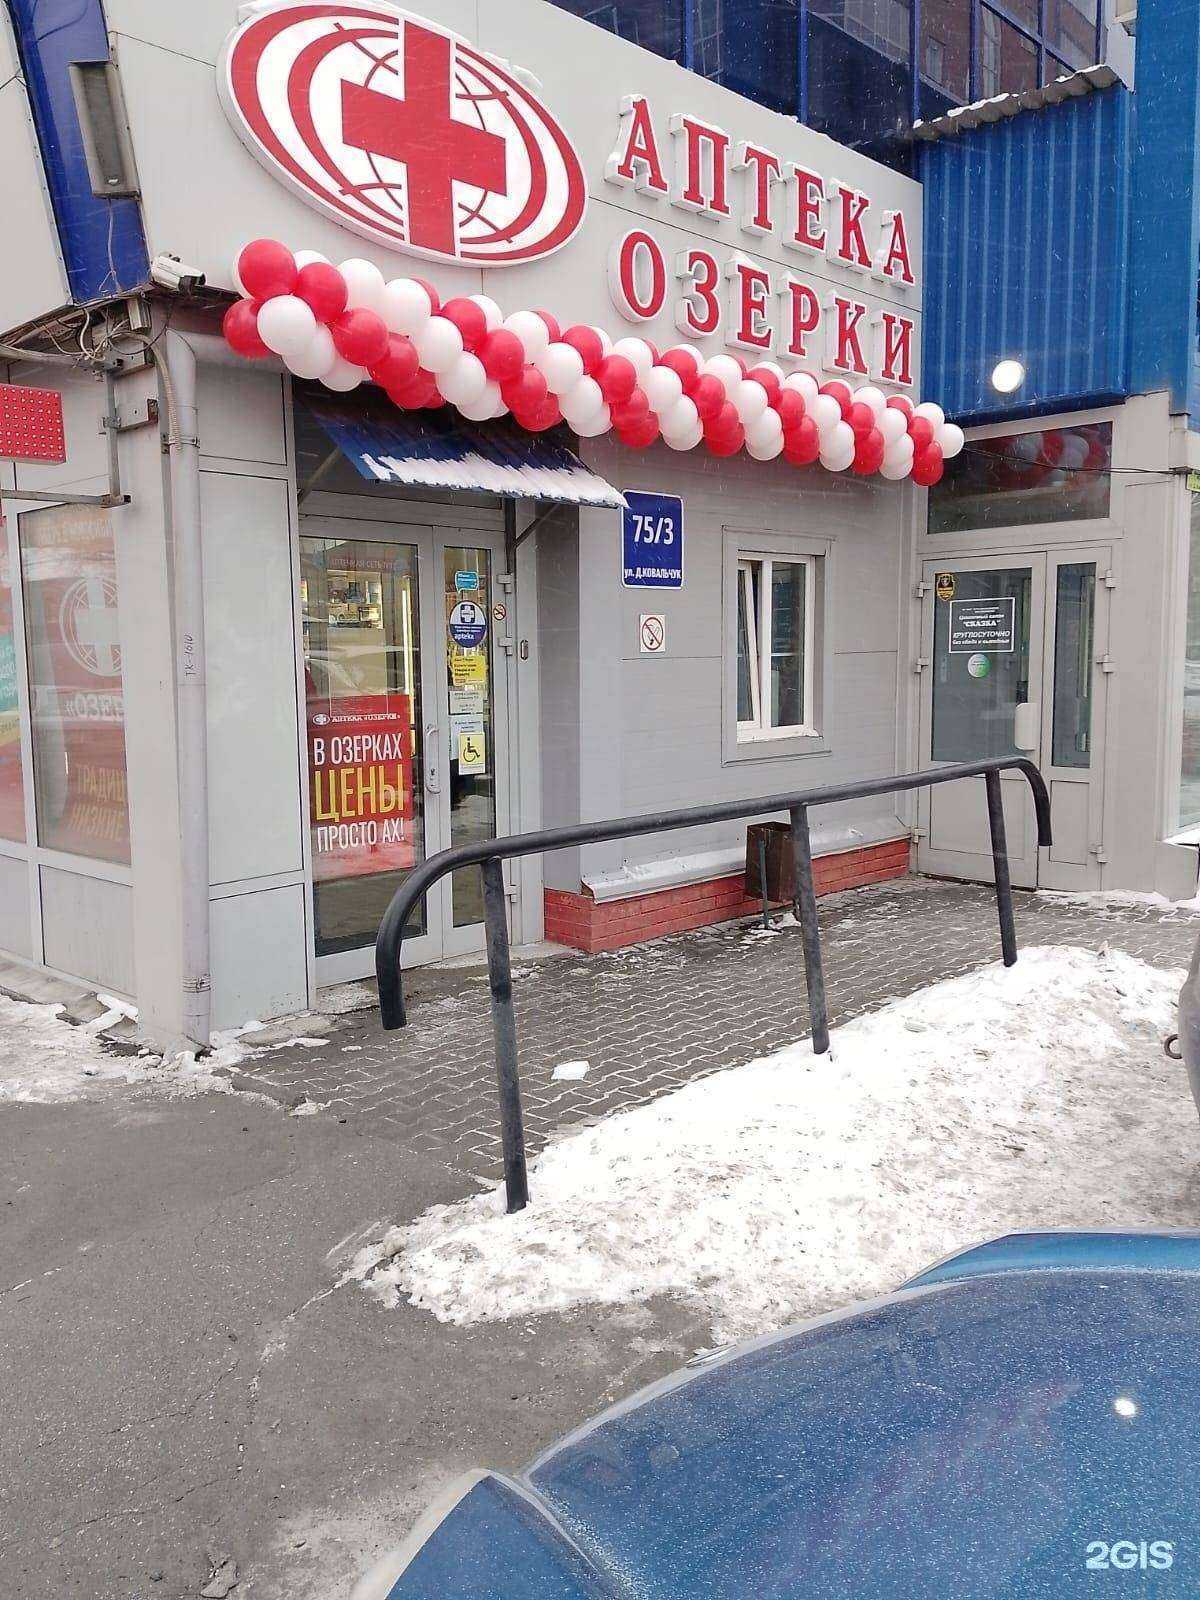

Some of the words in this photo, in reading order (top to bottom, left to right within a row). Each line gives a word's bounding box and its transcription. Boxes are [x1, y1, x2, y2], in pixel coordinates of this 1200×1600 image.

[612, 97, 916, 286] АПТЕКА
[616, 230, 914, 386] ОЗЕРКИ
[632, 514, 674, 545] 75/3
[624, 568, 635, 579] ул.
[635, 567, 682, 580] Д.КОВАЛЬЧУК
[313, 737, 325, 766] В
[331, 732, 403, 765] ОЗЕРКАХ
[314, 764, 404, 823] ЦЕНЫ
[317, 820, 377, 853] ПРОСТО
[382, 816, 405, 845] АХ!
